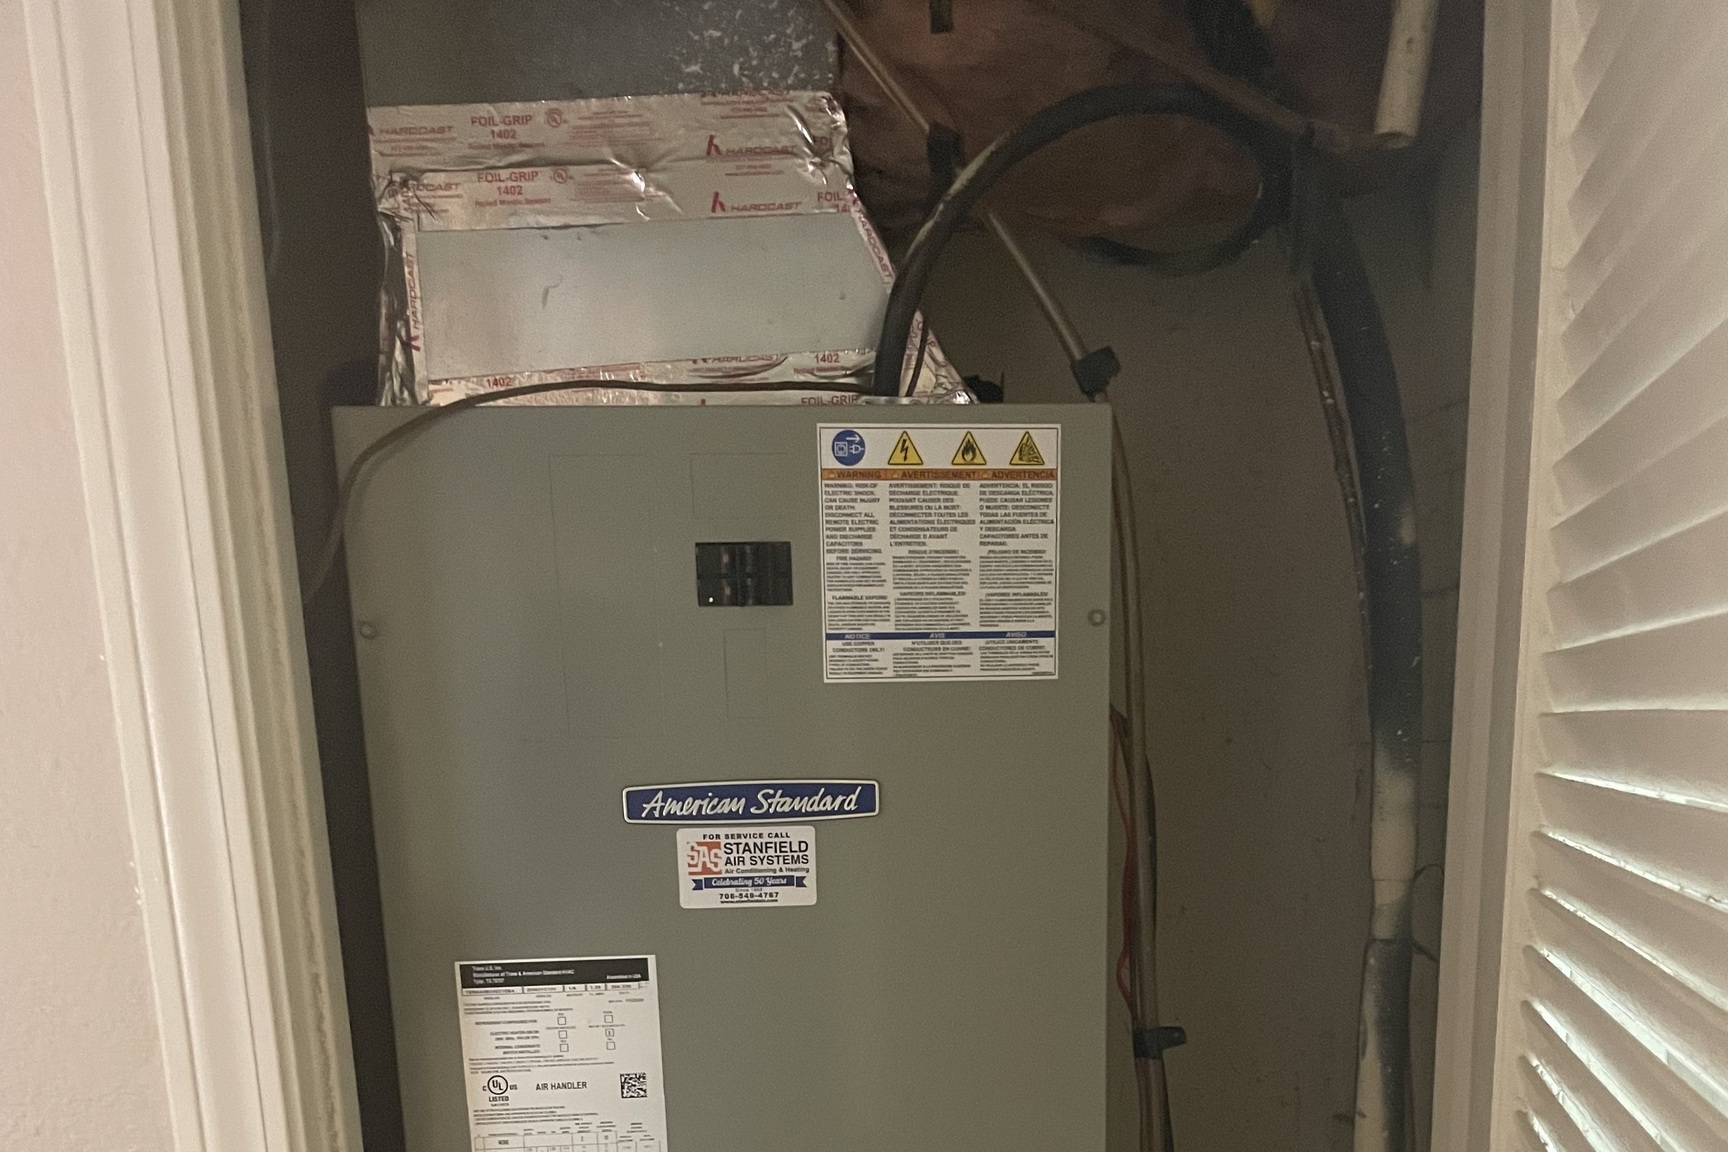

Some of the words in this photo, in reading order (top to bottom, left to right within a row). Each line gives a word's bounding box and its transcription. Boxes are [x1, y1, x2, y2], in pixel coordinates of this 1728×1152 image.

[471, 116, 532, 126] FOIL-GRIP
[491, 130, 516, 139] 1402
[726, 146, 797, 155] HARDCAST
[478, 171, 539, 182] FOIL-GRIP
[497, 186, 523, 196] 1402
[731, 202, 802, 211] HARDCAST
[815, 354, 840, 364] 1402
[487, 378, 512, 387] 1402
[902, 471, 976, 479] AVERTISSEMENT
[642, 790, 745, 818] American
[751, 786, 862, 814] Standard
[724, 841, 809, 854] STANFIELD
[688, 842, 722, 873] SAS
[725, 856, 745, 866] AIR
[750, 854, 809, 865] SYSTEMS
[712, 878, 752, 886] Celebrating
[536, 1083, 549, 1091] AIR
[551, 1081, 587, 1090] HANDLER
